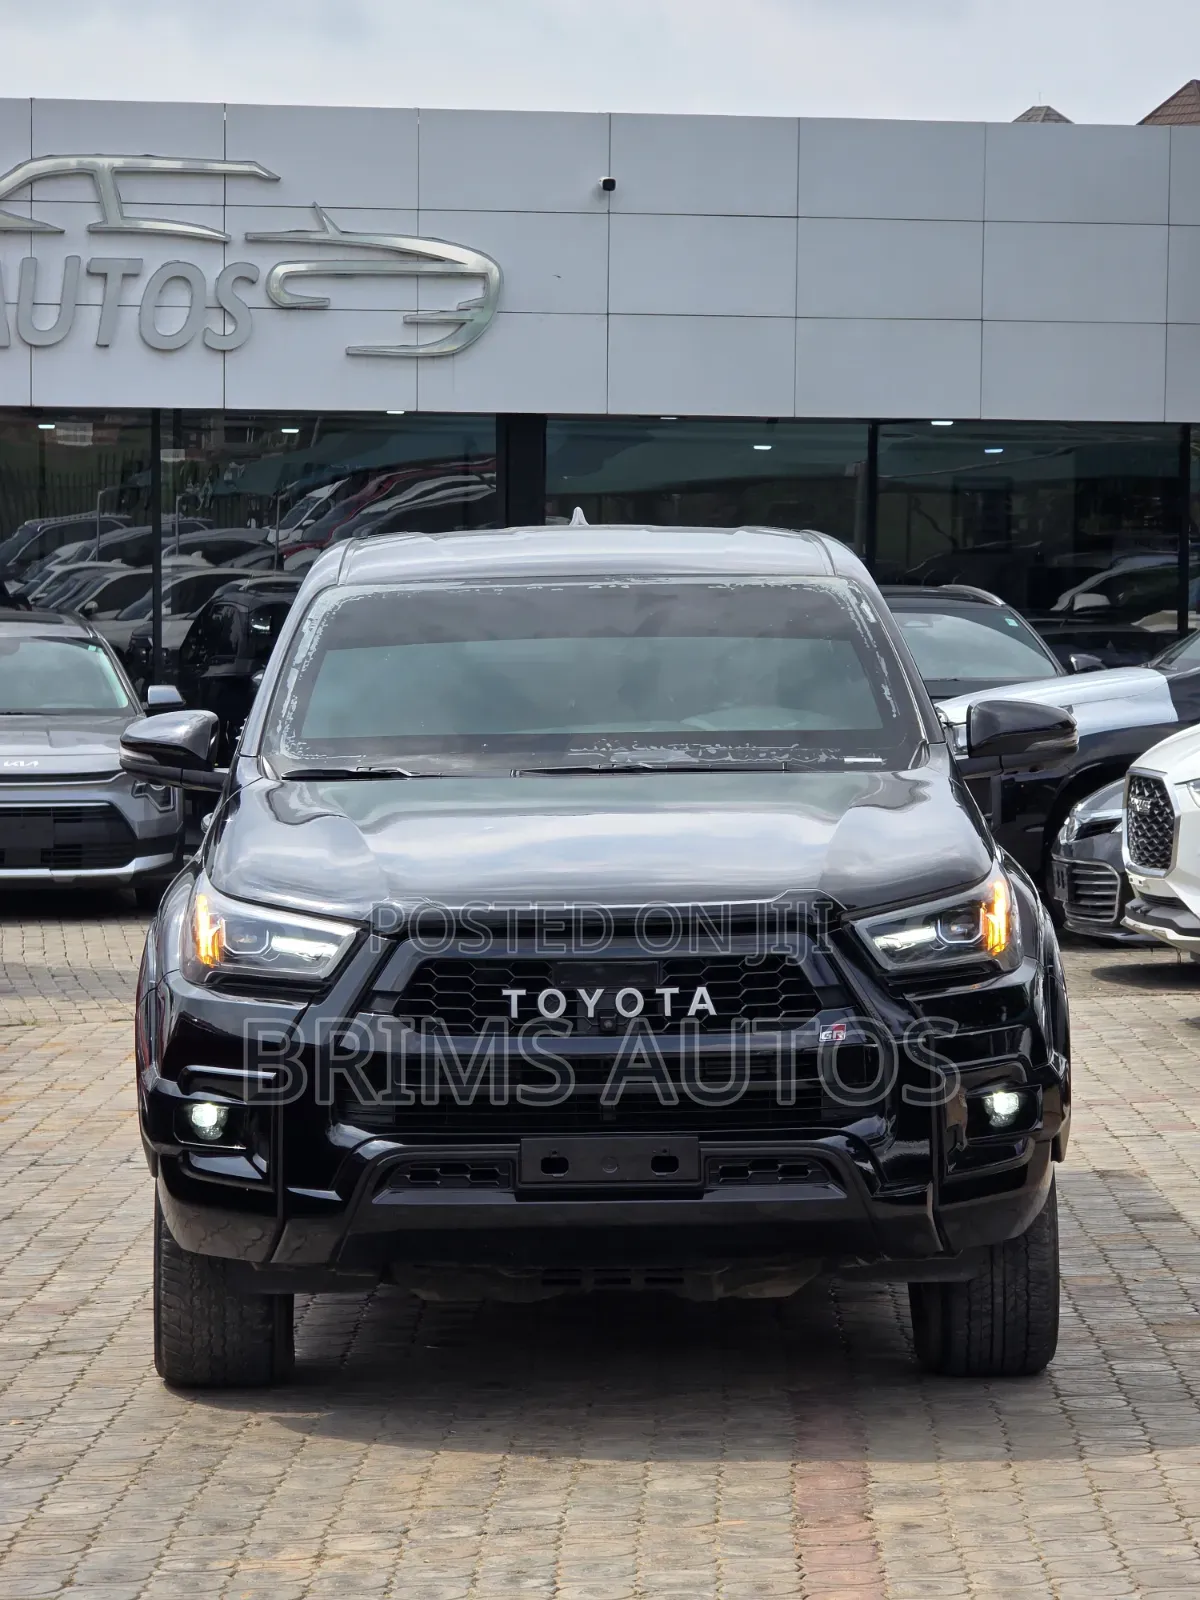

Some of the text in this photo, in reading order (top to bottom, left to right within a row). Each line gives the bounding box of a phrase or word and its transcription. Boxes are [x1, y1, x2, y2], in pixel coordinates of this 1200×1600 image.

[0, 255, 260, 351] UTOS
[502, 986, 718, 1019] TOYOTA
[820, 1029, 846, 1041] GR
